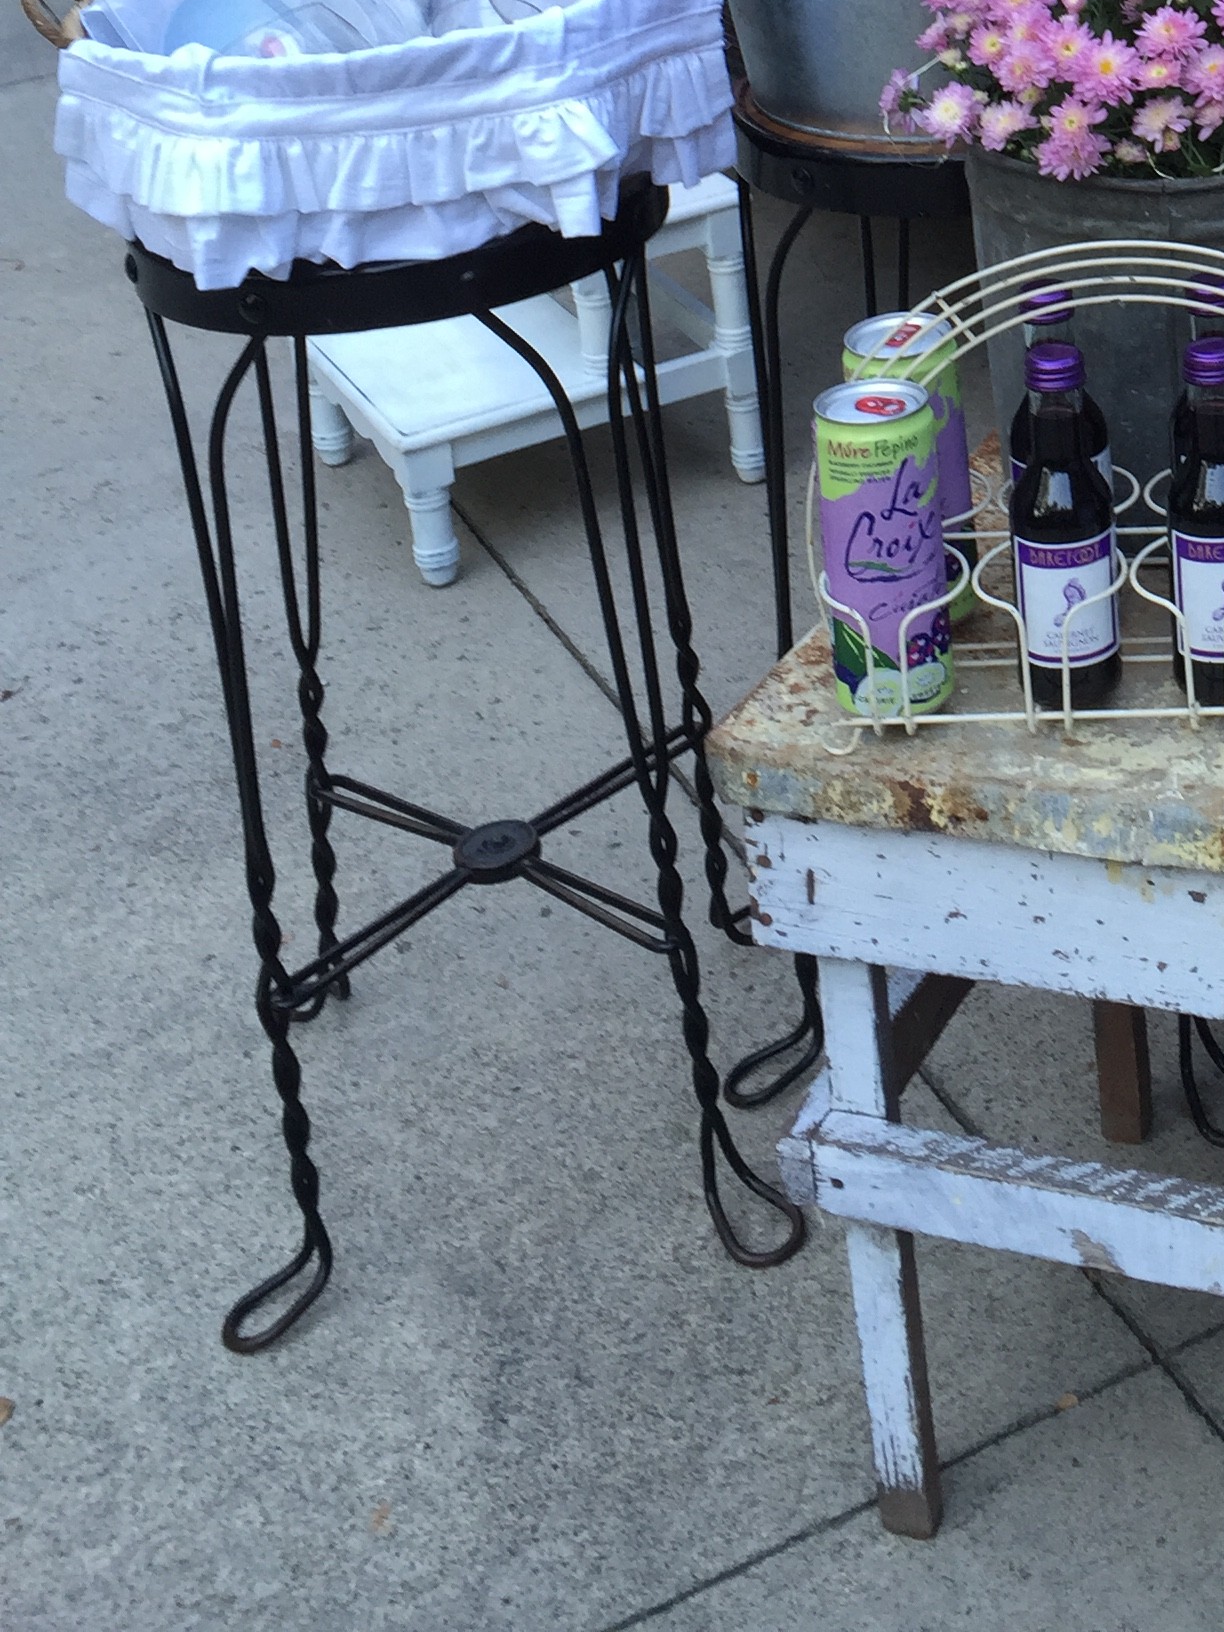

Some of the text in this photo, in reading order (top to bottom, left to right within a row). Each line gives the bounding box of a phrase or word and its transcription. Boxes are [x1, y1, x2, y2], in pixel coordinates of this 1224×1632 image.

[881, 457, 924, 520] La
[845, 510, 935, 582] Croix
[1029, 544, 1103, 567] BAREFOOT
